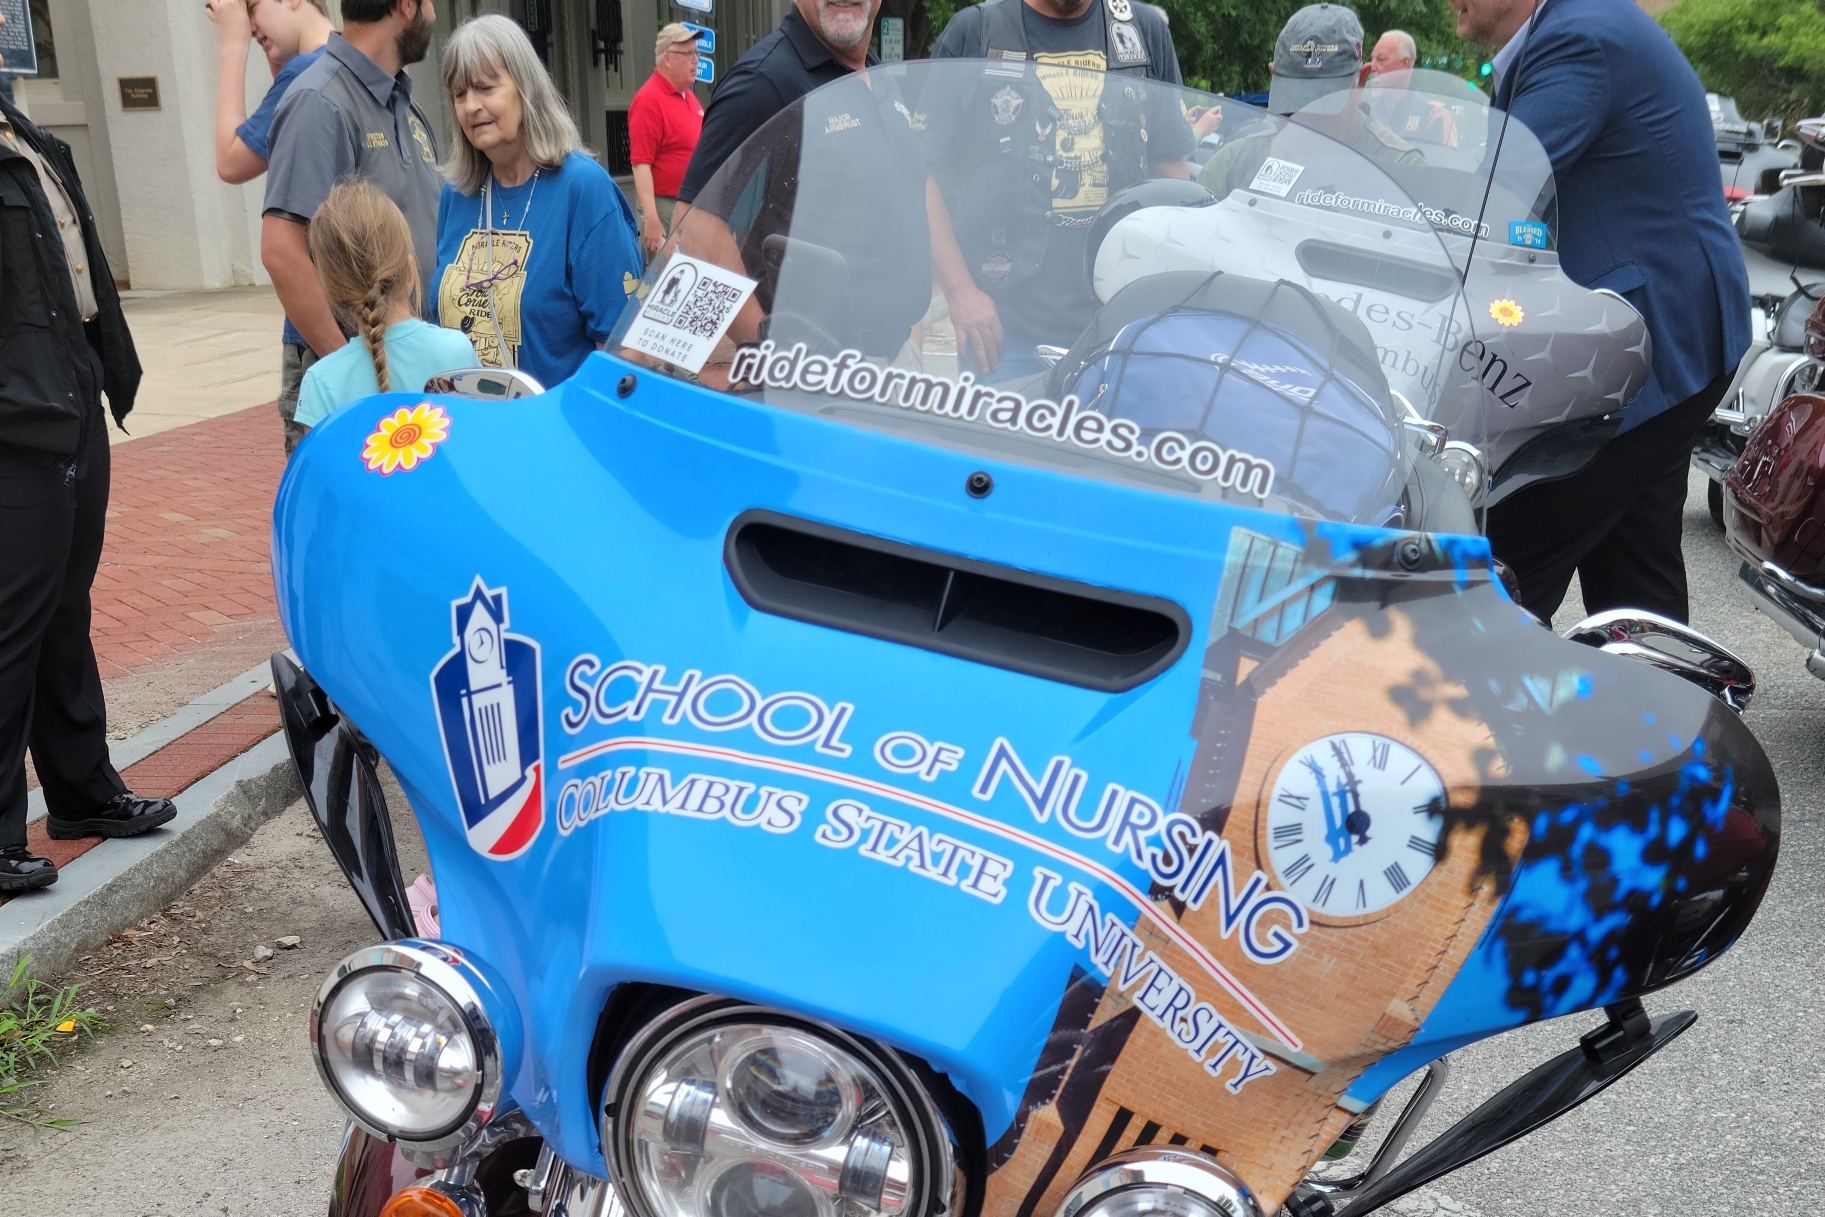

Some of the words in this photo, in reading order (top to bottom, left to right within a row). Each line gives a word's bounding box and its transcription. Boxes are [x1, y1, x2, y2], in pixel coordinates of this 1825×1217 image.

[1295, 189, 1490, 239] rideformiracles.com
[457, 292, 491, 308] Corne
[646, 303, 677, 318] MIRACLE
[636, 337, 649, 348] TO
[650, 343, 689, 363] DONATE
[643, 327, 668, 342] SCAN
[669, 336, 694, 352] HERE
[729, 340, 1274, 499] rideformiracles.com
[562, 655, 853, 756] SCHOOL
[875, 733, 963, 779] OF
[973, 738, 1308, 963] NURSING
[558, 767, 807, 835] COLUMBUS
[816, 799, 1012, 903] STATE
[1029, 867, 1275, 1095] UNIVERSITY
